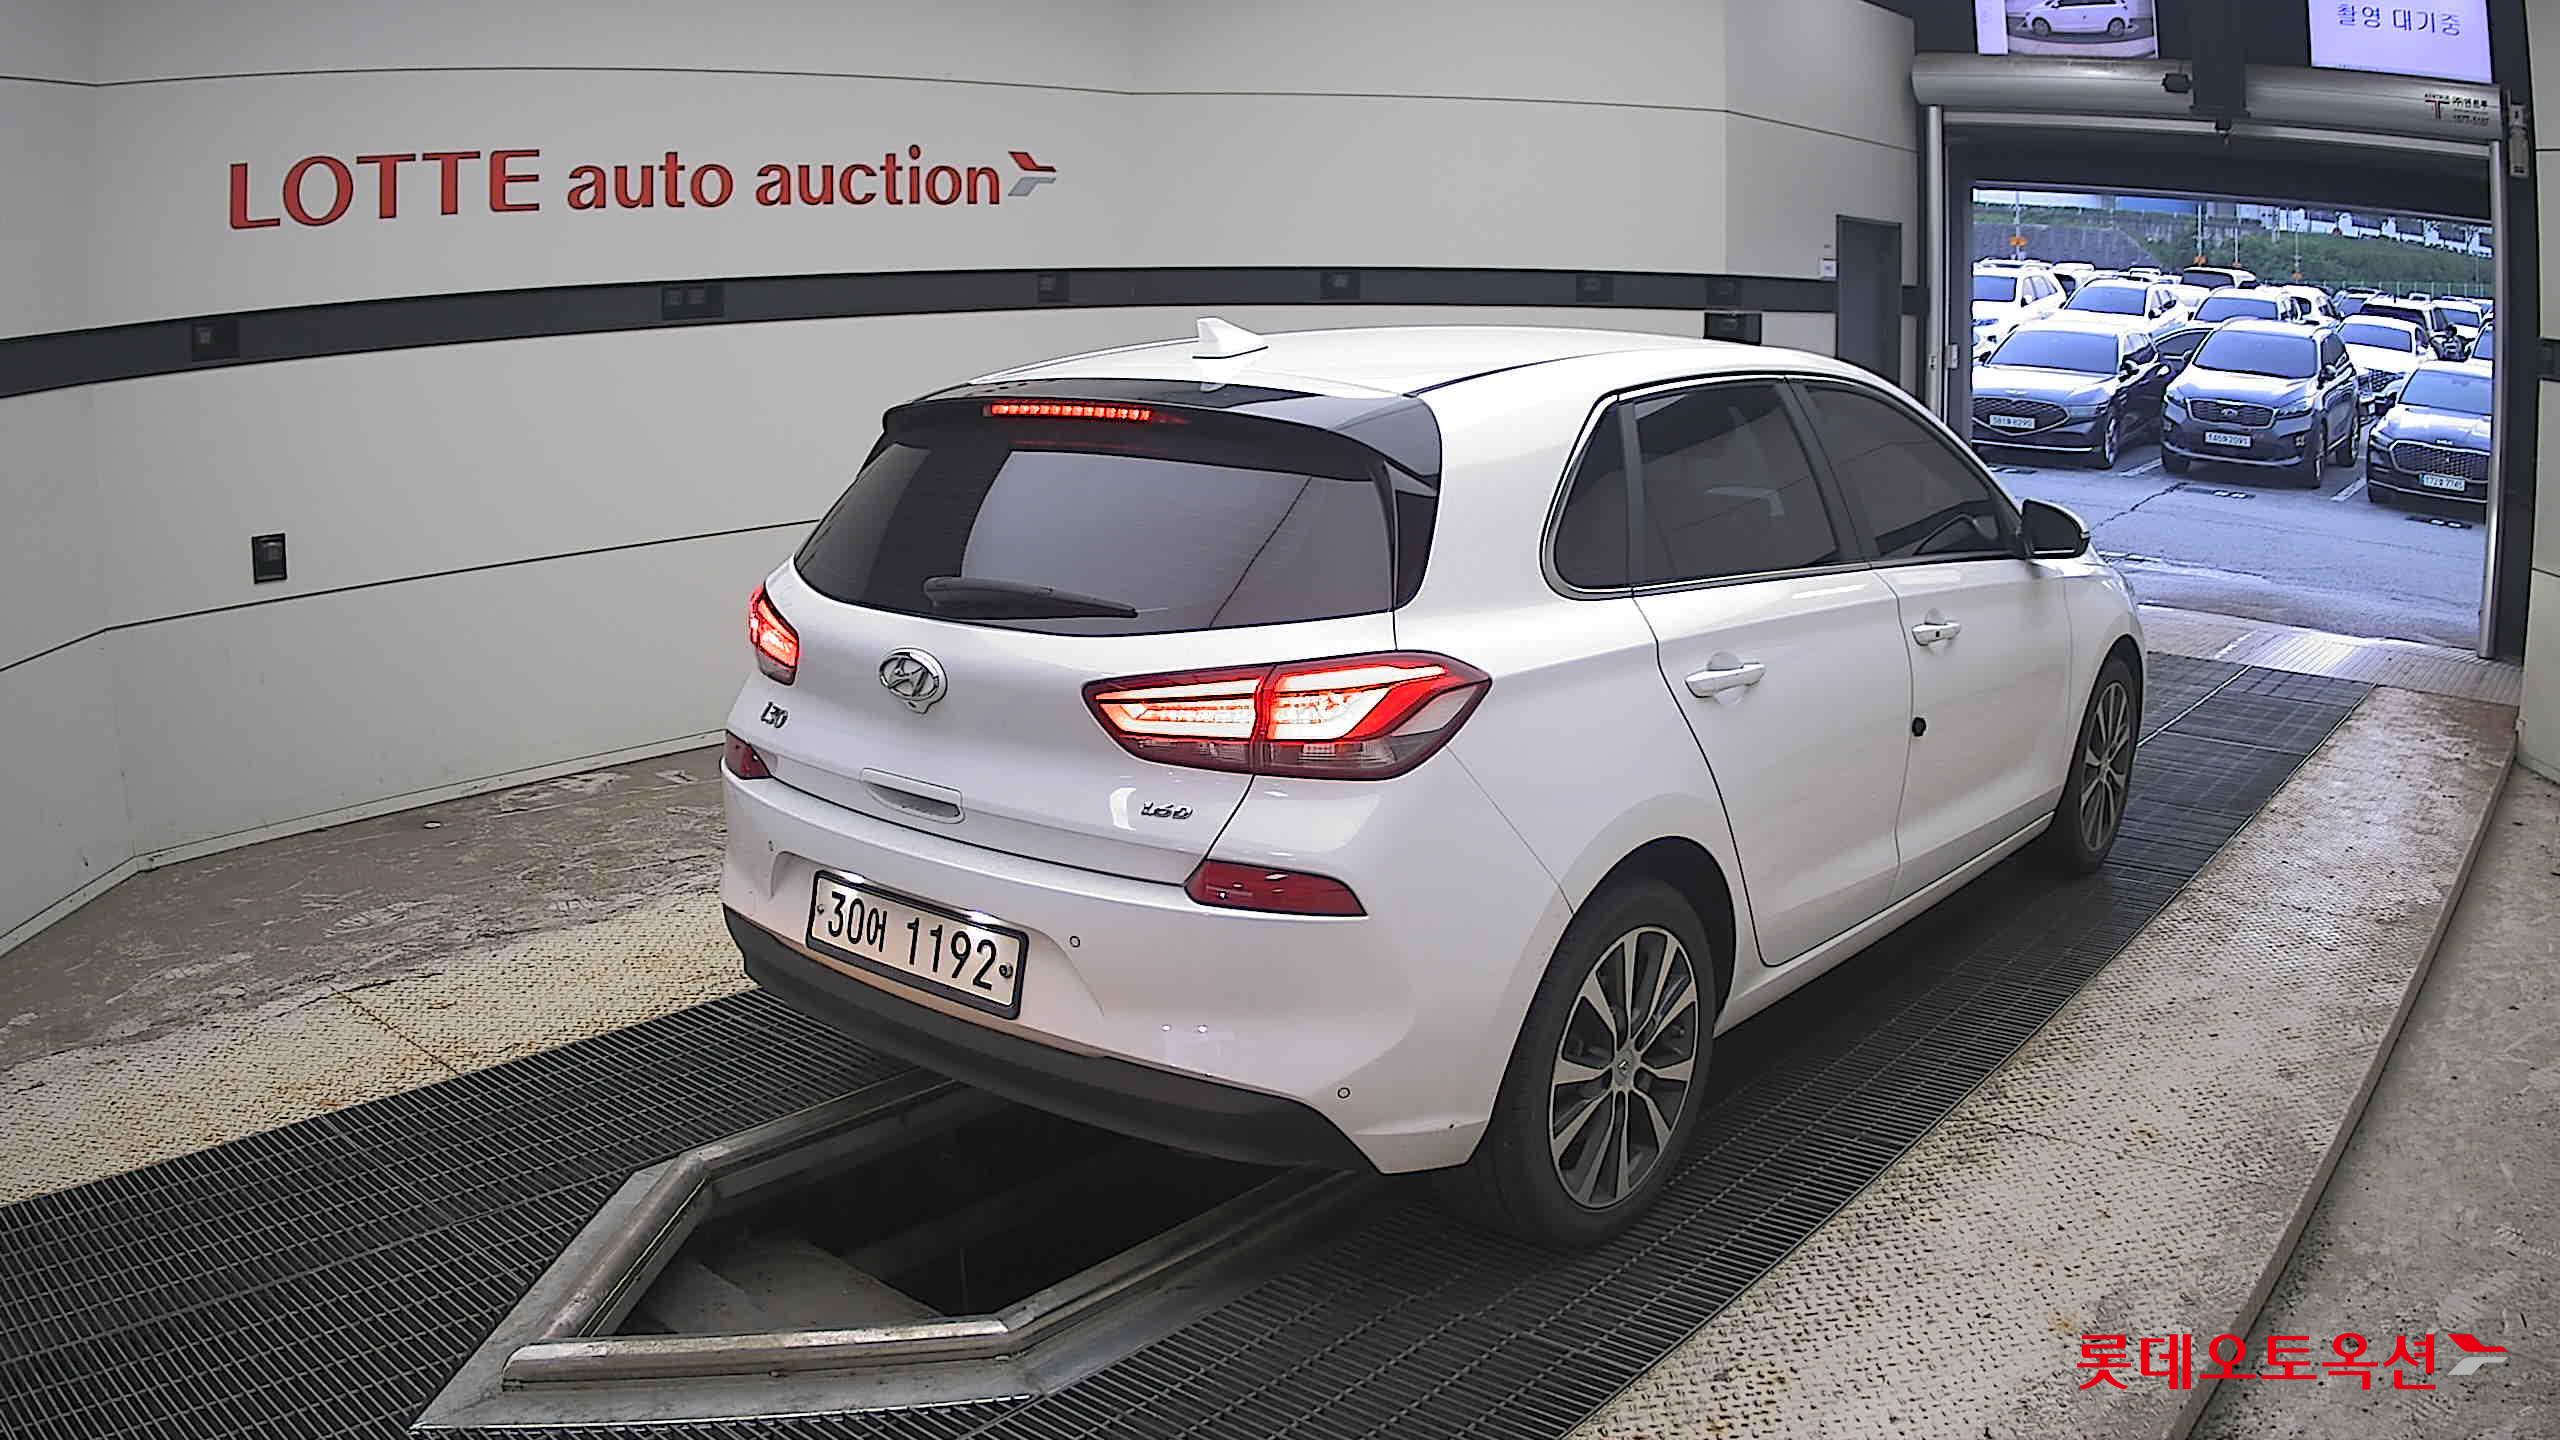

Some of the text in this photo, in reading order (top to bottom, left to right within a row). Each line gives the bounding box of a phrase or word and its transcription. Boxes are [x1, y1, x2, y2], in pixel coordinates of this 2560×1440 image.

[2337, 3, 2461, 37] 촬영 대기중
[229, 144, 1001, 230] LOTTE auto auction
[828, 891, 998, 991] 30어 1192
